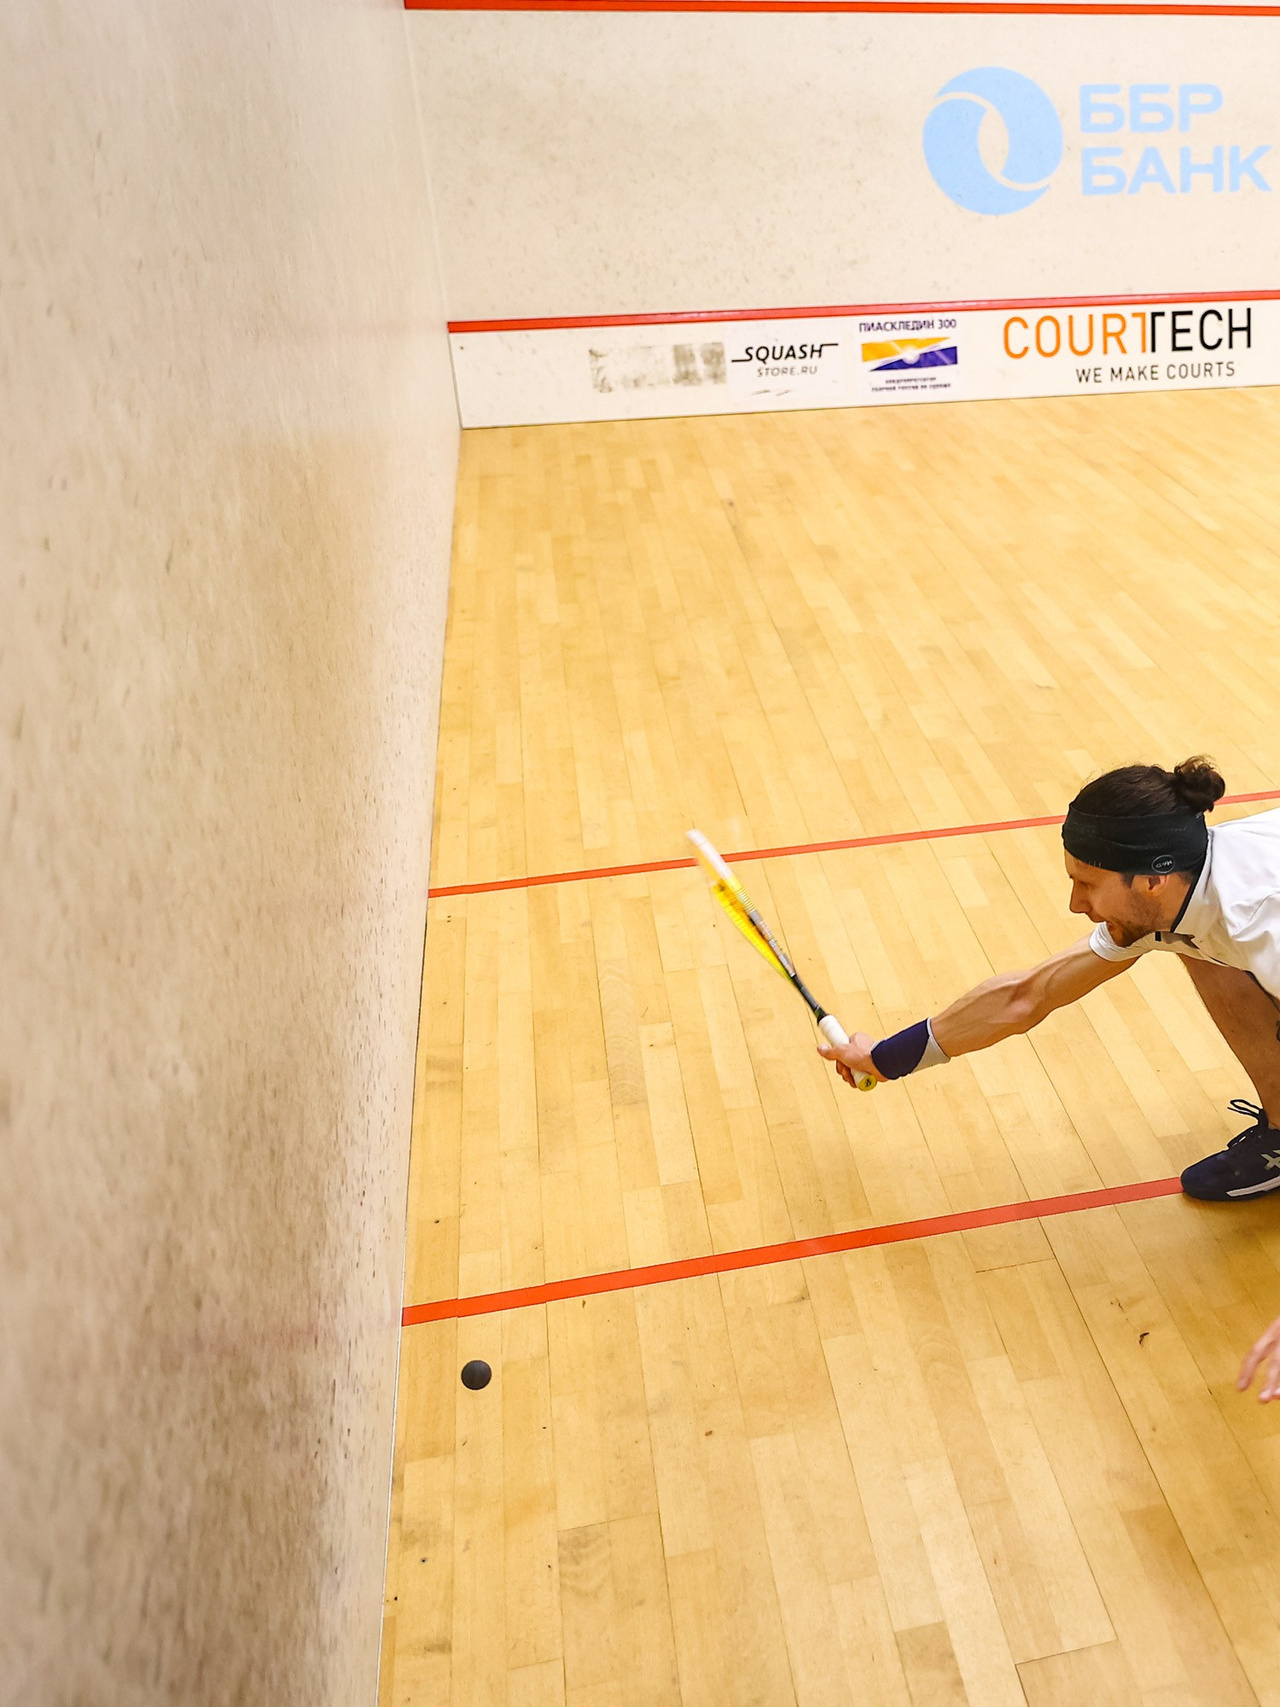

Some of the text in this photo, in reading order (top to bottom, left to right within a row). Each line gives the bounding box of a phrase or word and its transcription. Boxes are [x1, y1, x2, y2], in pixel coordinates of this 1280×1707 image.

[1078, 83, 1224, 134] ББР
[1080, 145, 1273, 197] БАНК
[858, 318, 957, 333] ПИАСКЛЕДИН 300
[731, 342, 839, 364] SQUASH
[756, 365, 818, 379] STORE.RU
[1076, 361, 1235, 384] WE MAKE COURTS
